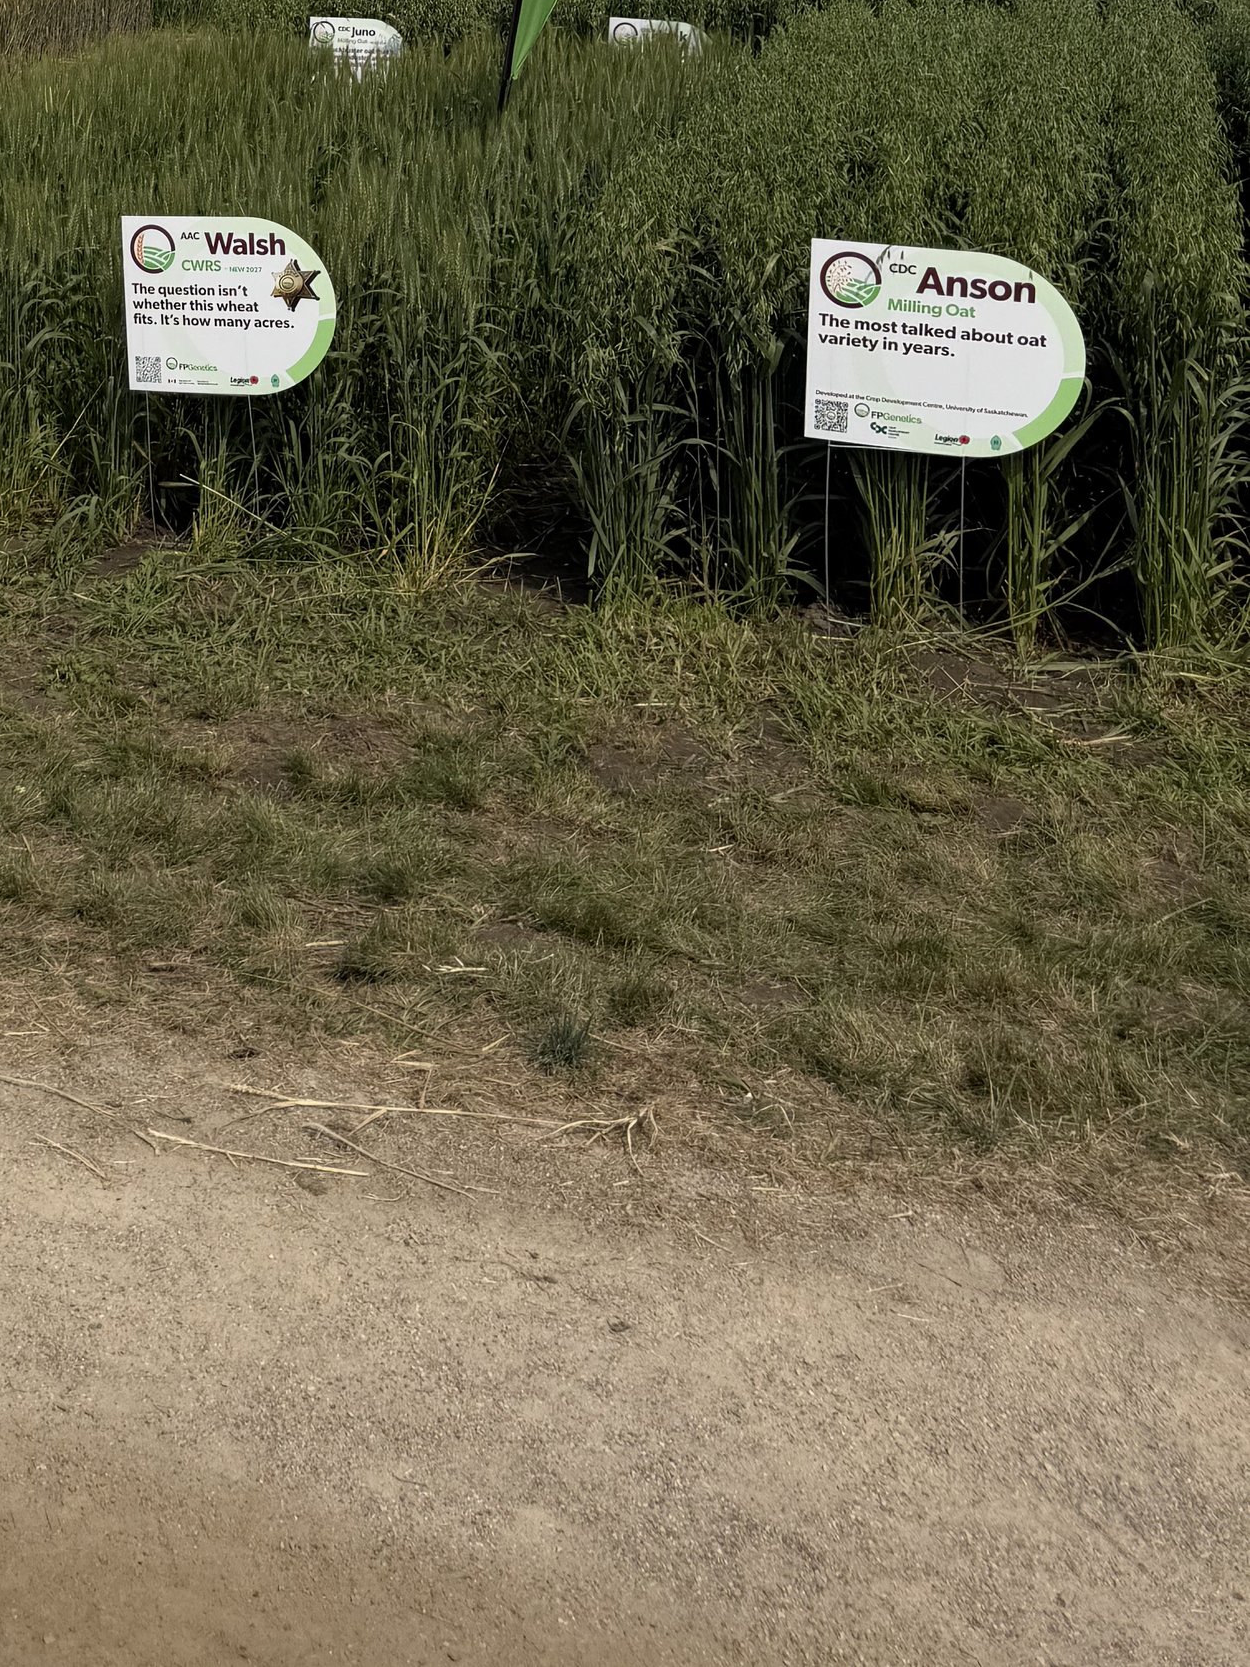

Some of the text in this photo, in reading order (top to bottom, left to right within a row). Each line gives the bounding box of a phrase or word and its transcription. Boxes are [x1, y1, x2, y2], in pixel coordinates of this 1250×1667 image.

[351, 26, 376, 38] Juno
[180, 231, 286, 256] AAC Walsh
[181, 260, 222, 272] CWRS
[131, 283, 248, 298] The question isn't
[889, 263, 1036, 304] CDC Anson
[132, 298, 259, 313] whether this wheat
[887, 298, 976, 319] Milling Oat
[133, 313, 295, 330] fits. It's how many acres.
[818, 313, 1047, 348] The most talked about oat
[818, 333, 956, 358] variety in years.
[815, 389, 848, 399] Developed
[866, 395, 881, 403] Crop
[881, 397, 922, 407] Development
[945, 403, 976, 413] University
[871, 410, 923, 424] FPGenetics
[934, 433, 959, 443] Legion
